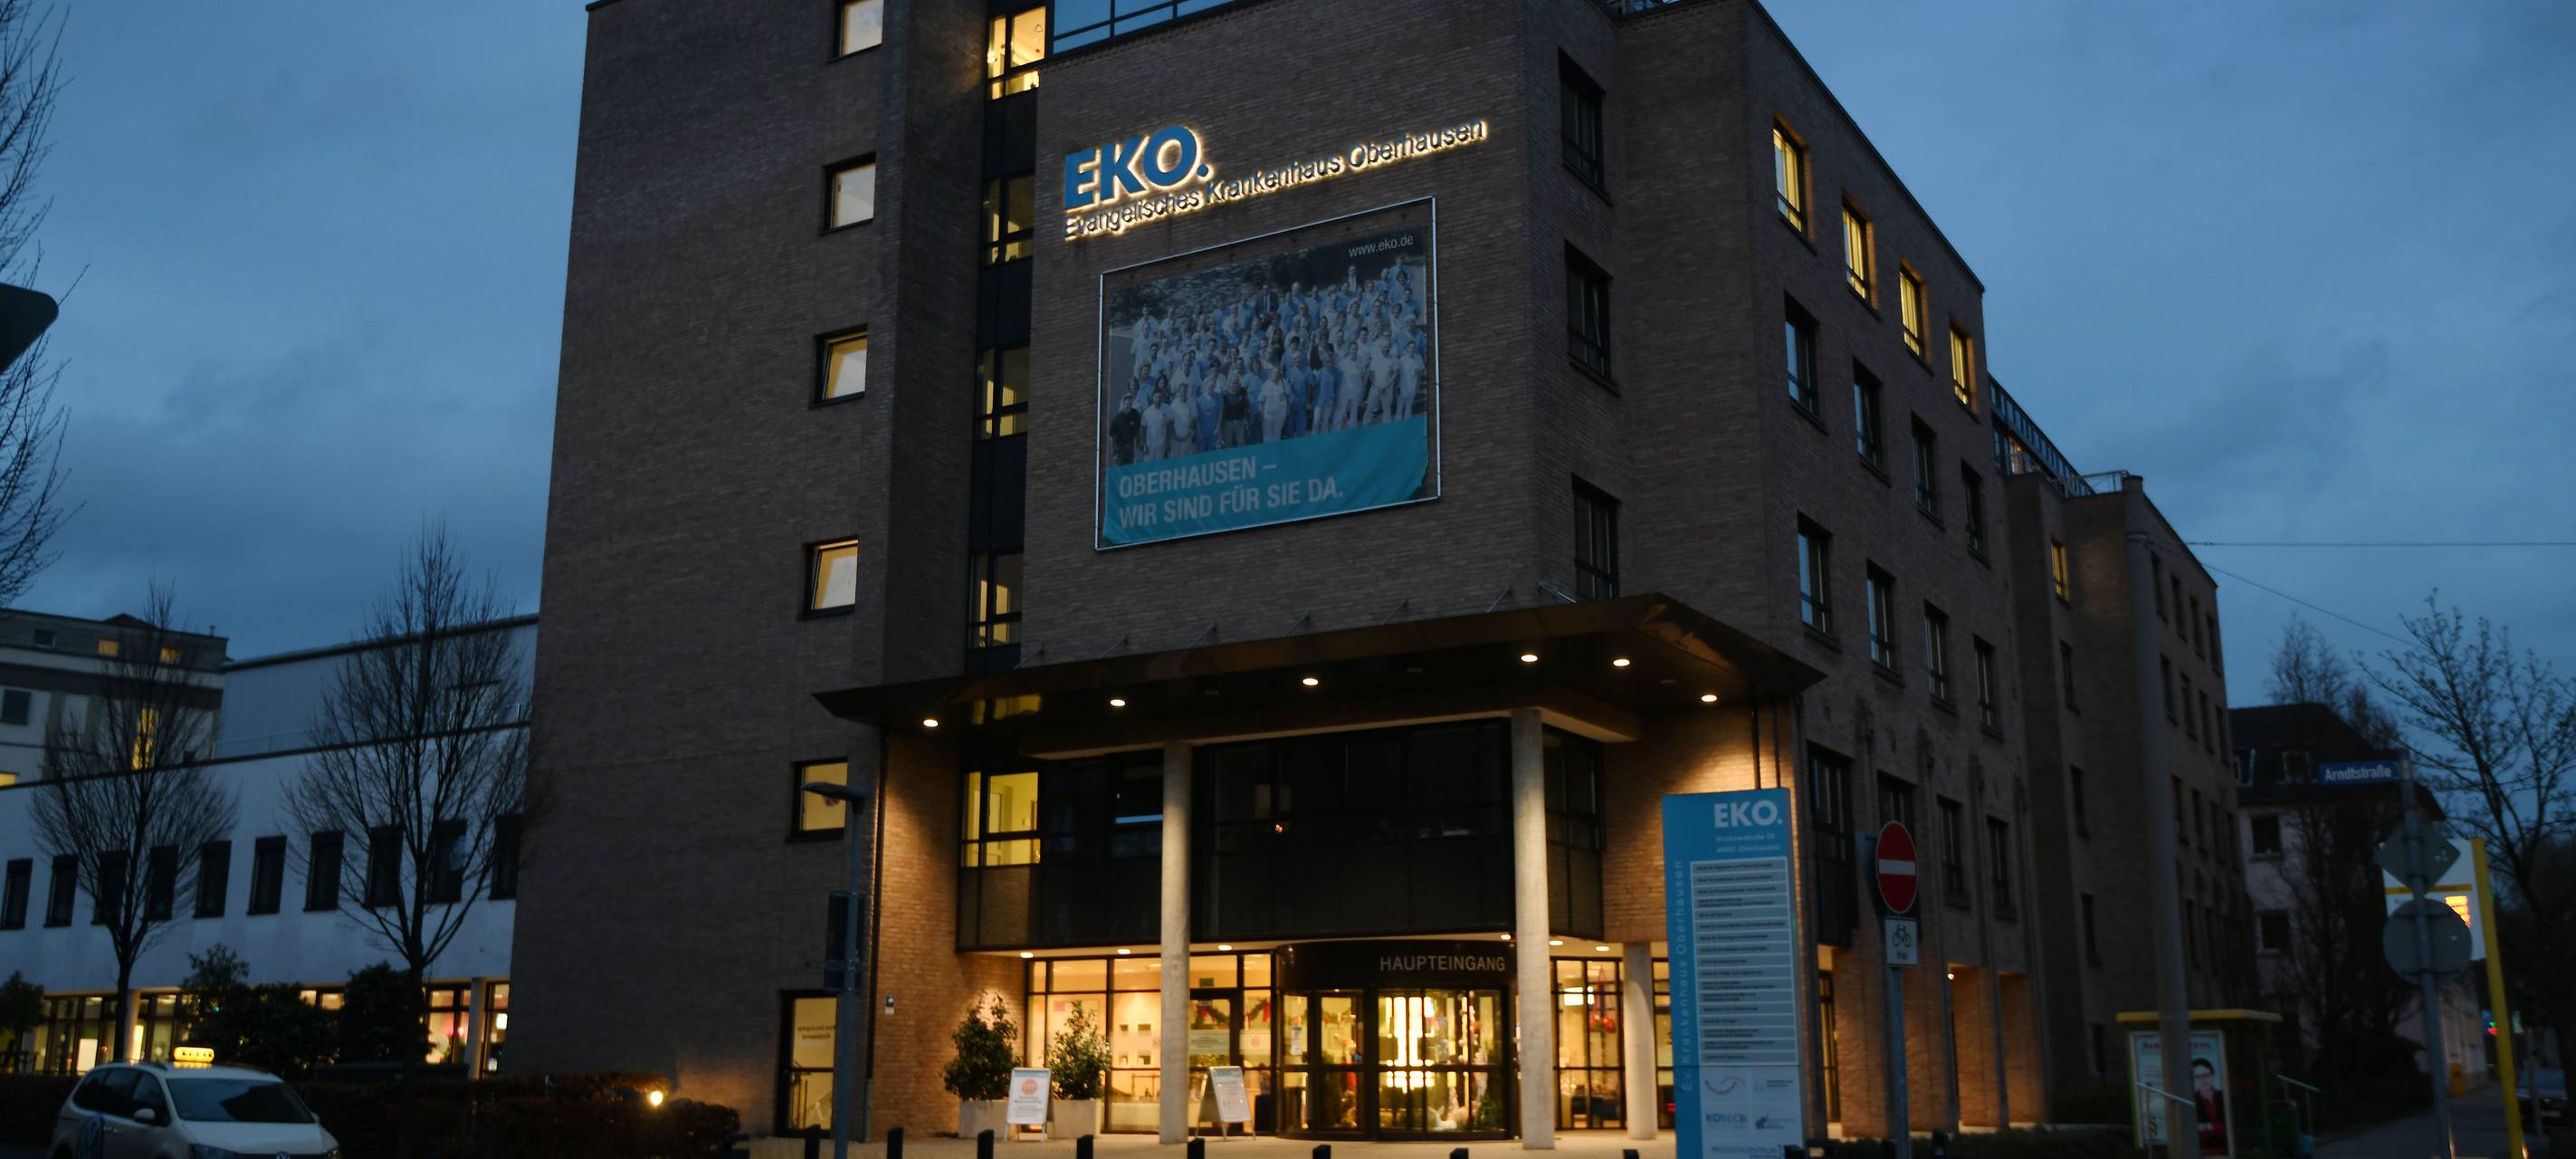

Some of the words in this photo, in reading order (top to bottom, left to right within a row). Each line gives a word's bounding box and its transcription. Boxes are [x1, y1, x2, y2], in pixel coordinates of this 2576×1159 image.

[1064, 125, 1209, 209] EKO.
[1064, 190, 1199, 237] Evangelisches
[1205, 156, 1341, 204] Krankenhaus
[1348, 120, 1484, 168] Oberhausen
[1348, 234, 1414, 258] www.eko.de
[1119, 455, 1257, 498] OBERHAUSEN
[1119, 503, 1158, 530] WIR
[1163, 494, 1214, 523] SIND
[1219, 484, 1261, 515] FÜR
[1267, 480, 1302, 509] SIE
[1307, 476, 1344, 503] DA.
[2324, 764, 2391, 781] Arndtstraße
[1713, 800, 1783, 829] EKO.
[1674, 861, 1686, 954] Oberhausen
[1379, 955, 1506, 972] HAUPTEINGANG
[1679, 961, 1691, 1065] Krankenhaus
